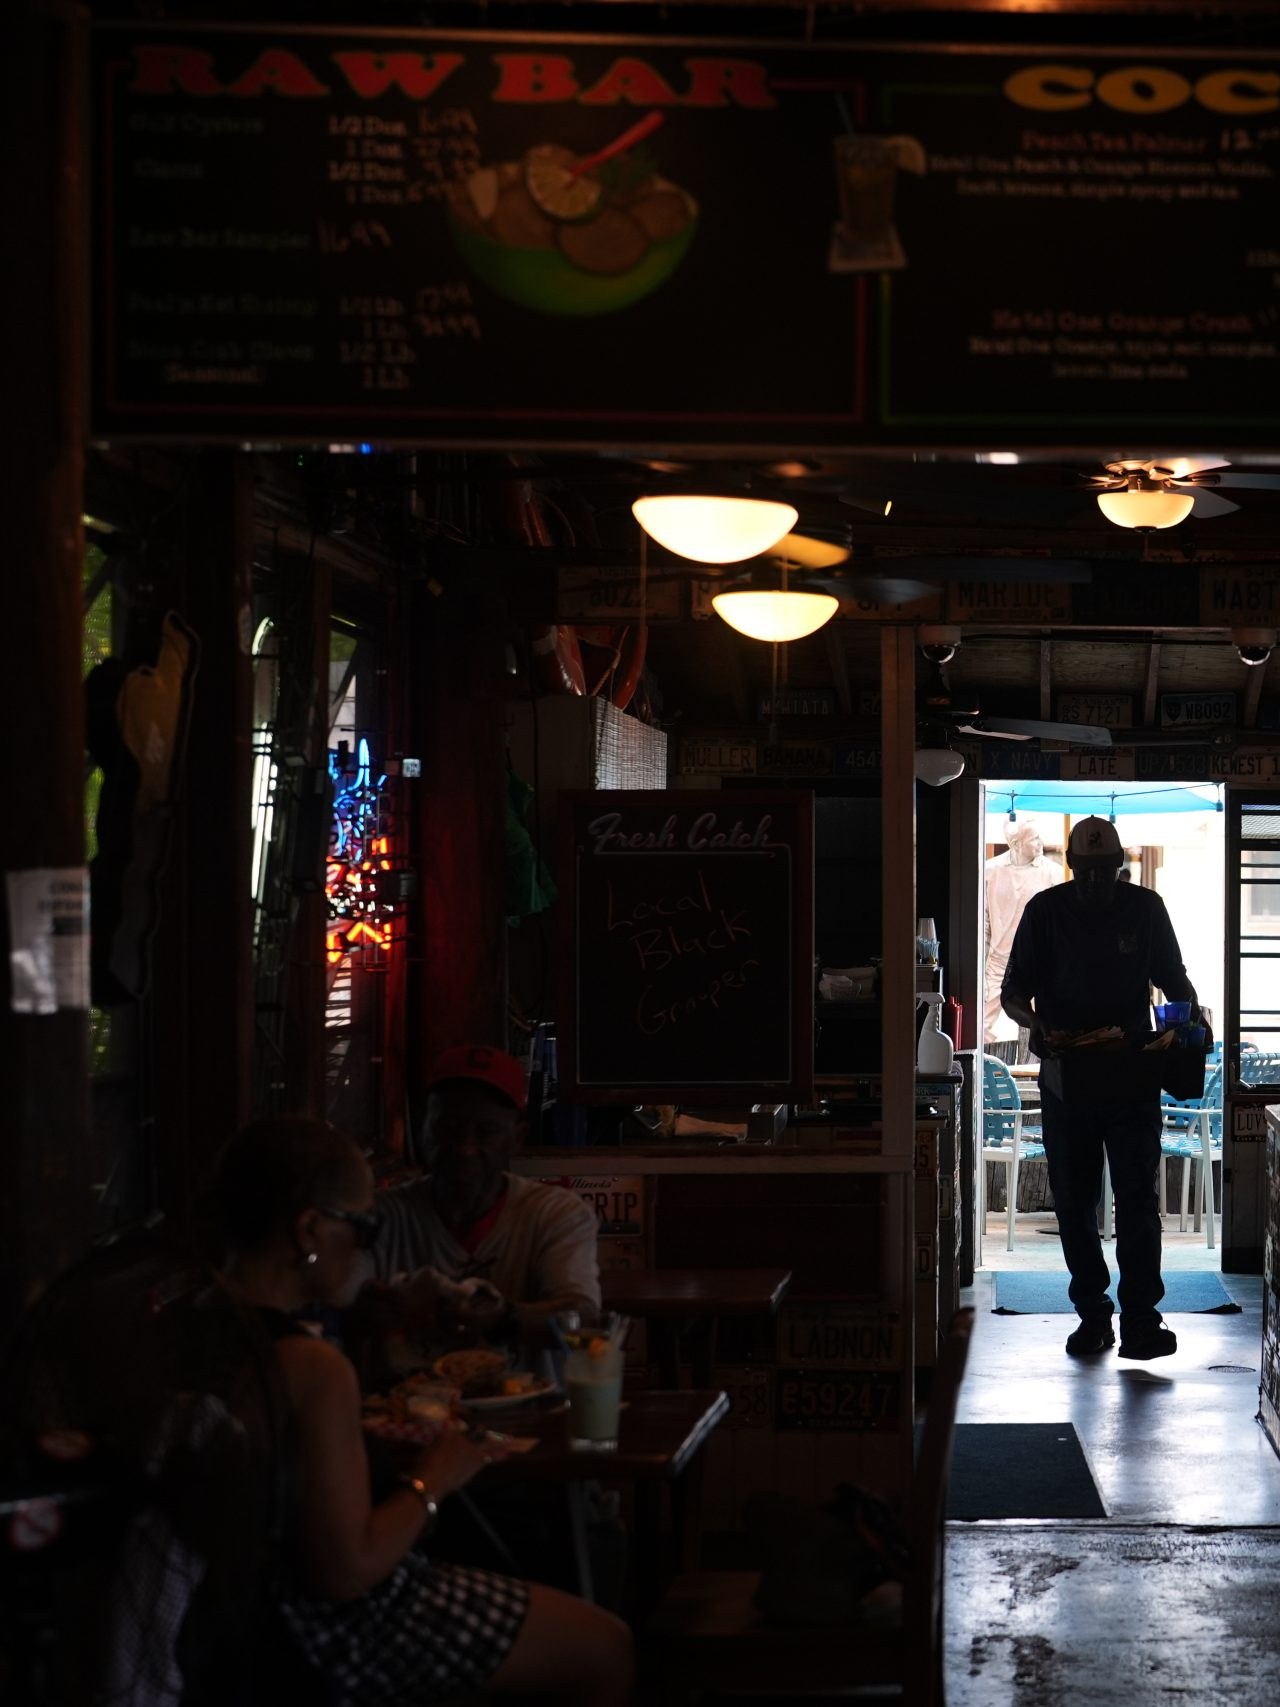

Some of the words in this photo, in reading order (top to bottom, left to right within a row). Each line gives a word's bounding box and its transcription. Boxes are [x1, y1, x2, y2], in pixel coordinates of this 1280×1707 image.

[127, 44, 464, 98] RAW
[491, 51, 779, 109] BAR
[1077, 753, 1118, 776] LATE
[588, 813, 679, 856] Fresh
[687, 812, 773, 850] Catch
[607, 868, 712, 932] Local
[628, 908, 752, 972] Black
